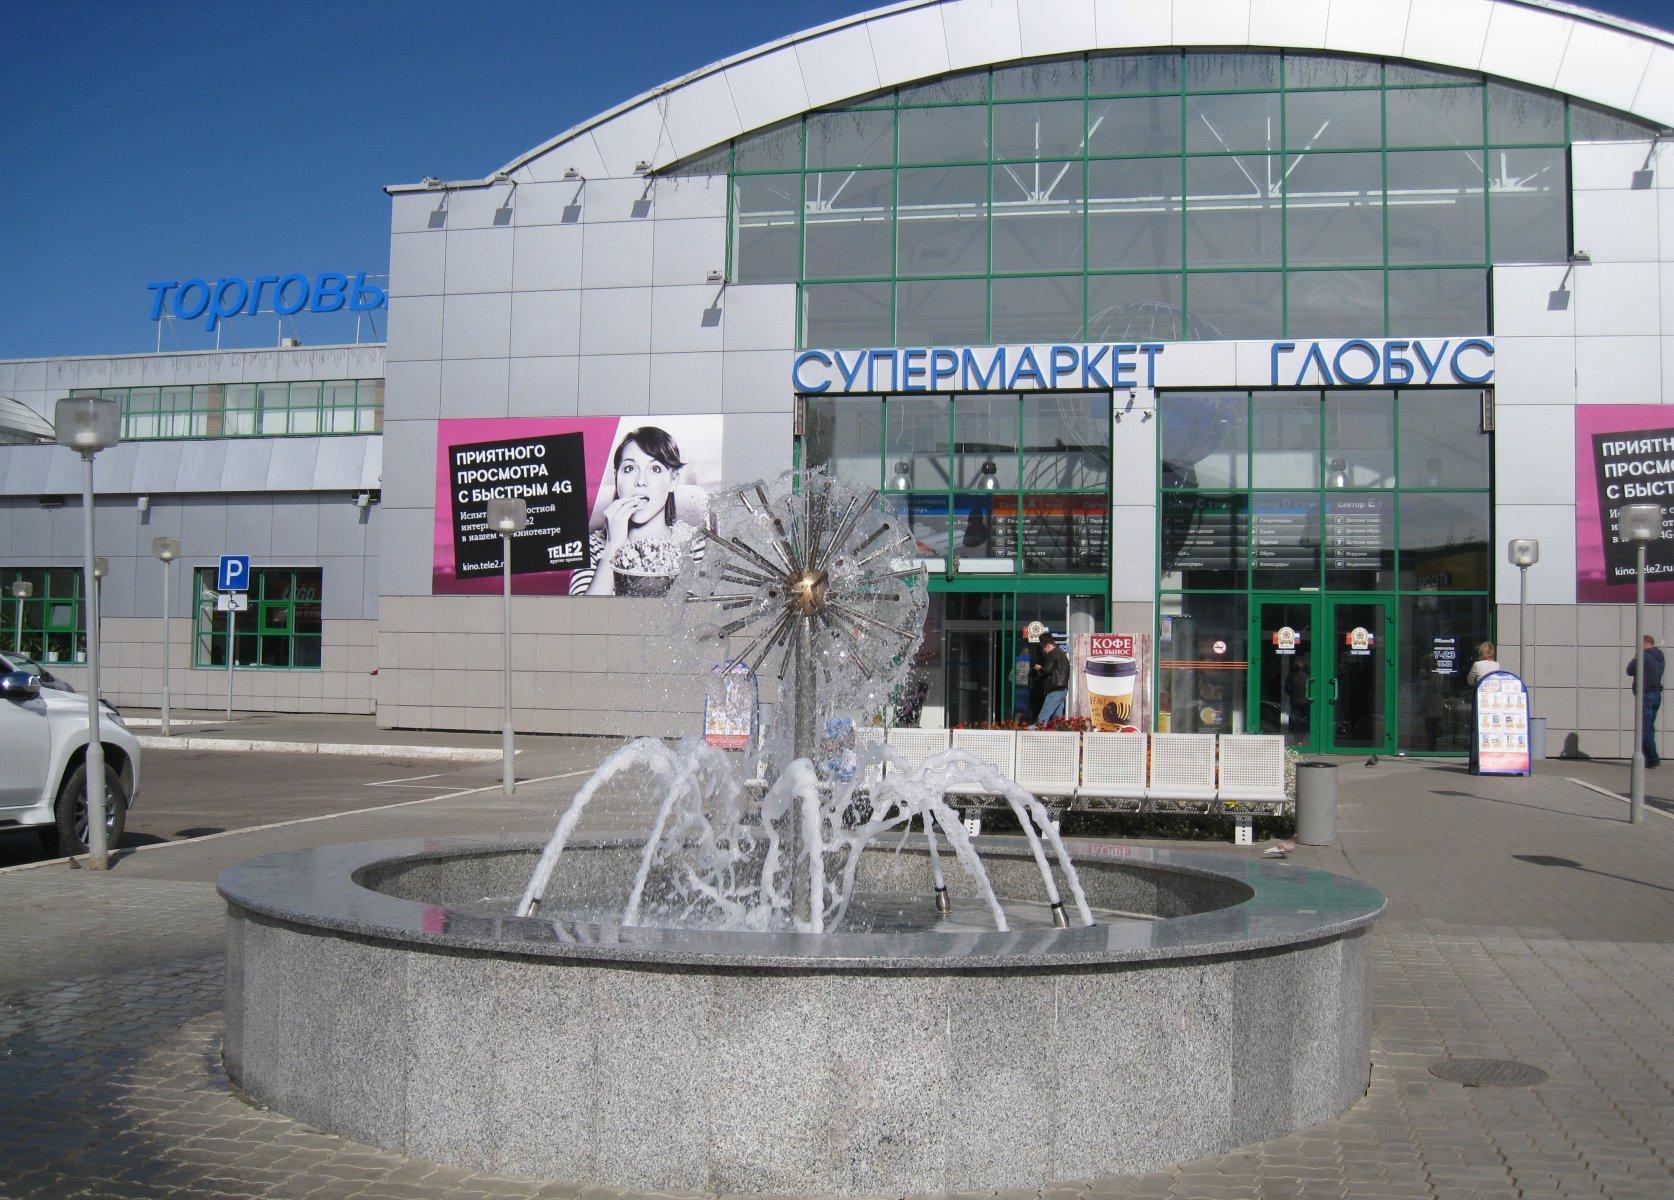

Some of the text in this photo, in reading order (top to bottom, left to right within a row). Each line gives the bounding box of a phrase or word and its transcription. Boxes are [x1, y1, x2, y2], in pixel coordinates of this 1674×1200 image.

[792, 338, 1495, 393] СУПЕРМАРКЕТ ГЛОБУС
[456, 444, 546, 466] ПРИЯТНОГО
[457, 463, 549, 485] ПРОСМОТРА
[458, 480, 572, 503] С БЫСТРЫМ 4G
[1606, 485, 1620, 499] С
[469, 533, 498, 542] нашем
[548, 541, 583, 559] TELE2
[226, 560, 243, 586] P
[463, 560, 505, 572] kino.tele2.r
[1615, 564, 1673, 576] kino.ele2.ru
[1092, 638, 1132, 649] КОФЕ
